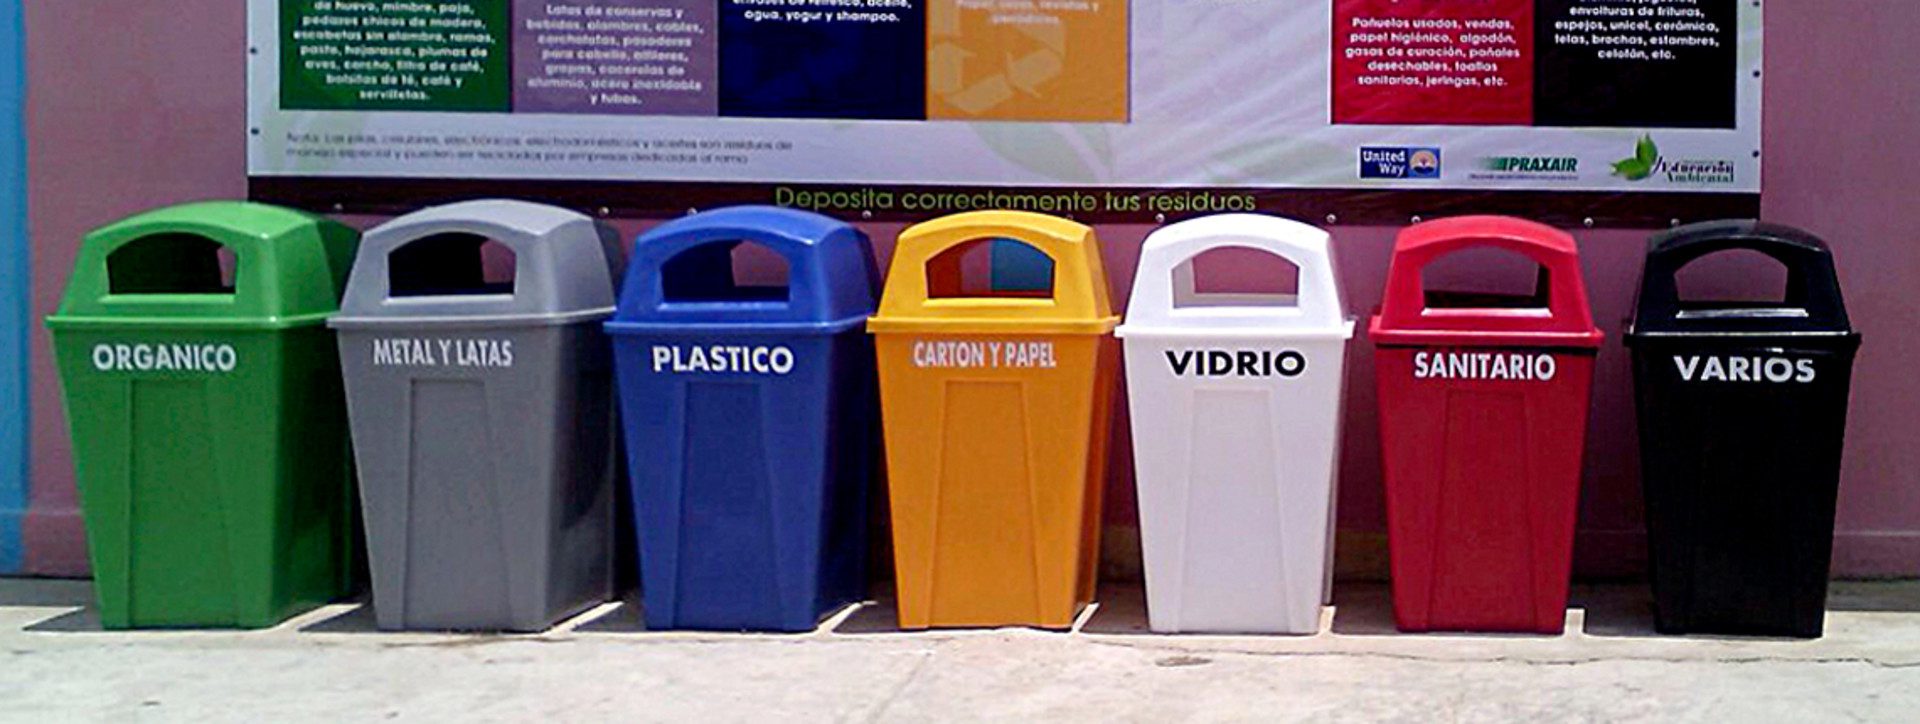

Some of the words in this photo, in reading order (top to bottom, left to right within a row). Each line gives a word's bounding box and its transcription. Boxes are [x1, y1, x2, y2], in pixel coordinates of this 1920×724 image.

[314, 1, 332, 10] de
[1569, 6, 1634, 16] envolturas
[1637, 6, 1654, 16] de
[585, 6, 601, 15] de
[675, 8, 683, 19] y
[785, 11, 822, 23] yogur
[825, 11, 833, 22] y
[409, 16, 426, 26] de
[1352, 17, 1410, 28] Pañuelos
[1412, 18, 1462, 29] usados,
[1465, 19, 1514, 30] vendas,
[365, 31, 384, 40] sin
[1350, 32, 1388, 43] papel
[470, 48, 487, 57] de
[1387, 46, 1403, 56] de
[429, 61, 446, 71] de
[667, 65, 685, 75] de
[1455, 60, 1497, 72] toallas
[380, 74, 397, 84] de
[454, 77, 462, 88] y
[590, 95, 598, 105] y
[1363, 150, 1405, 162] United
[1379, 163, 1405, 176] Way
[1509, 157, 1578, 171] PRAXAIR
[775, 186, 894, 210] Deposita
[901, 189, 1098, 211] correctamente
[1105, 190, 1141, 212] tus
[1148, 191, 1256, 213] residuos
[93, 344, 237, 371] ORGANICO
[373, 339, 435, 367] METAL
[438, 340, 454, 367] Y
[457, 341, 513, 367] LATAS
[913, 341, 988, 368] CARTON
[991, 341, 1005, 368] Y
[1006, 341, 1056, 368] PAPEL
[652, 345, 795, 374] PLASTICO
[1165, 350, 1307, 378] VIDRIO
[1414, 352, 1556, 382] SANITARIO
[1673, 355, 1815, 382] VARIOS
